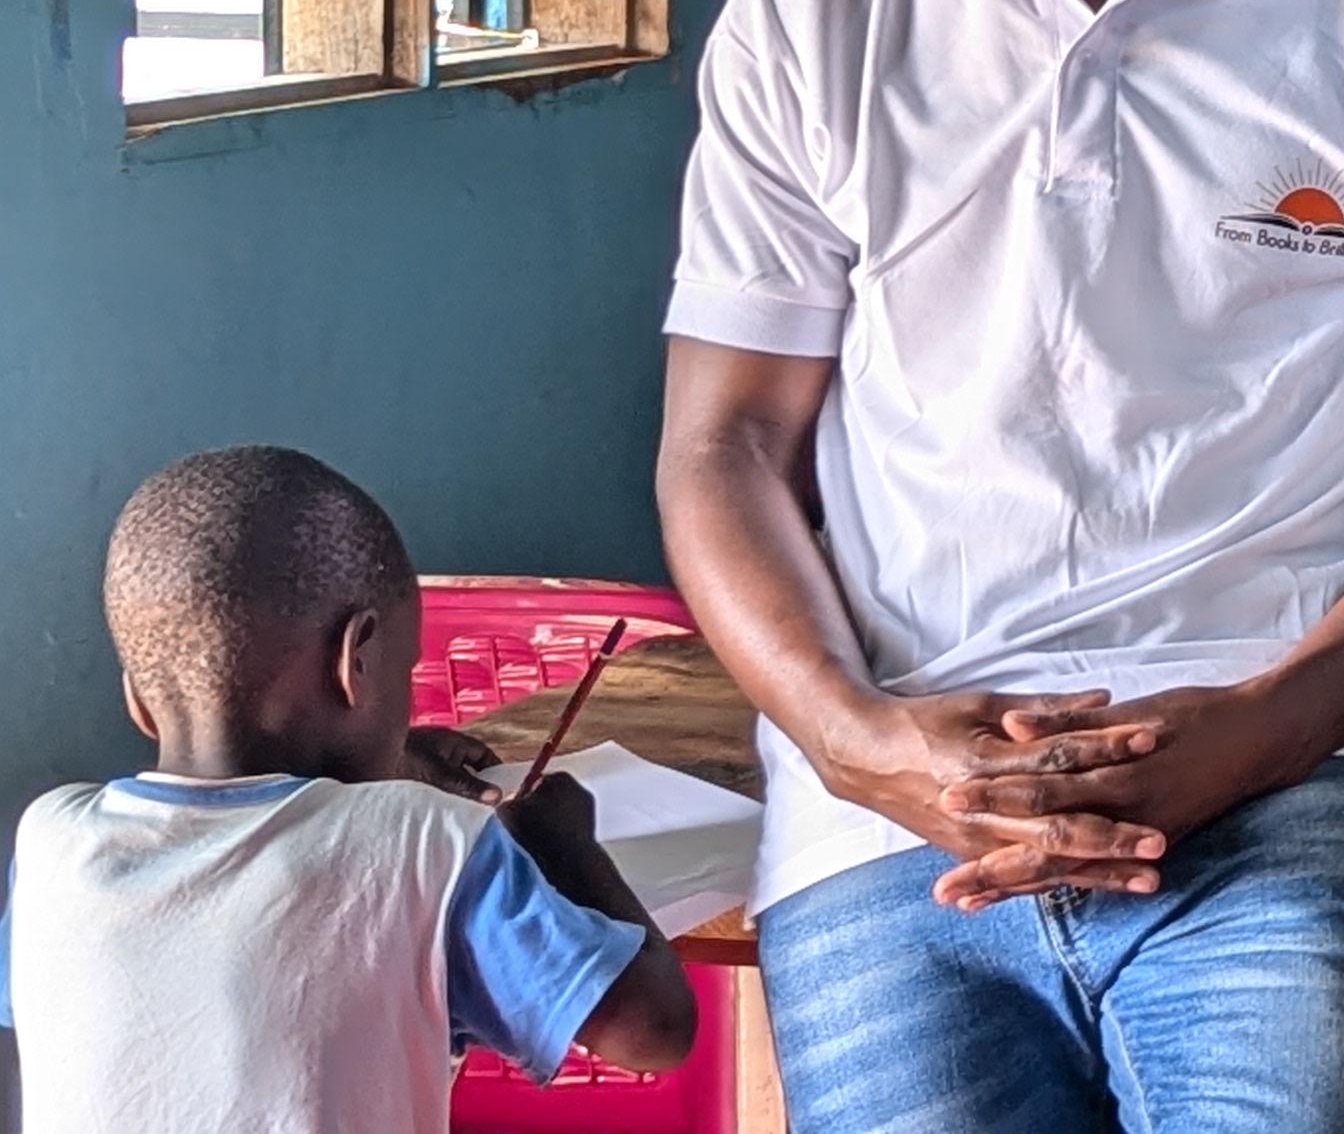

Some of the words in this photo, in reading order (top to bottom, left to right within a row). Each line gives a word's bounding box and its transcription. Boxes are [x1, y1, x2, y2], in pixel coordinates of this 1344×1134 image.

[1214, 221, 1252, 243] From
[1257, 229, 1299, 252] Books
[1302, 238, 1316, 254] to
